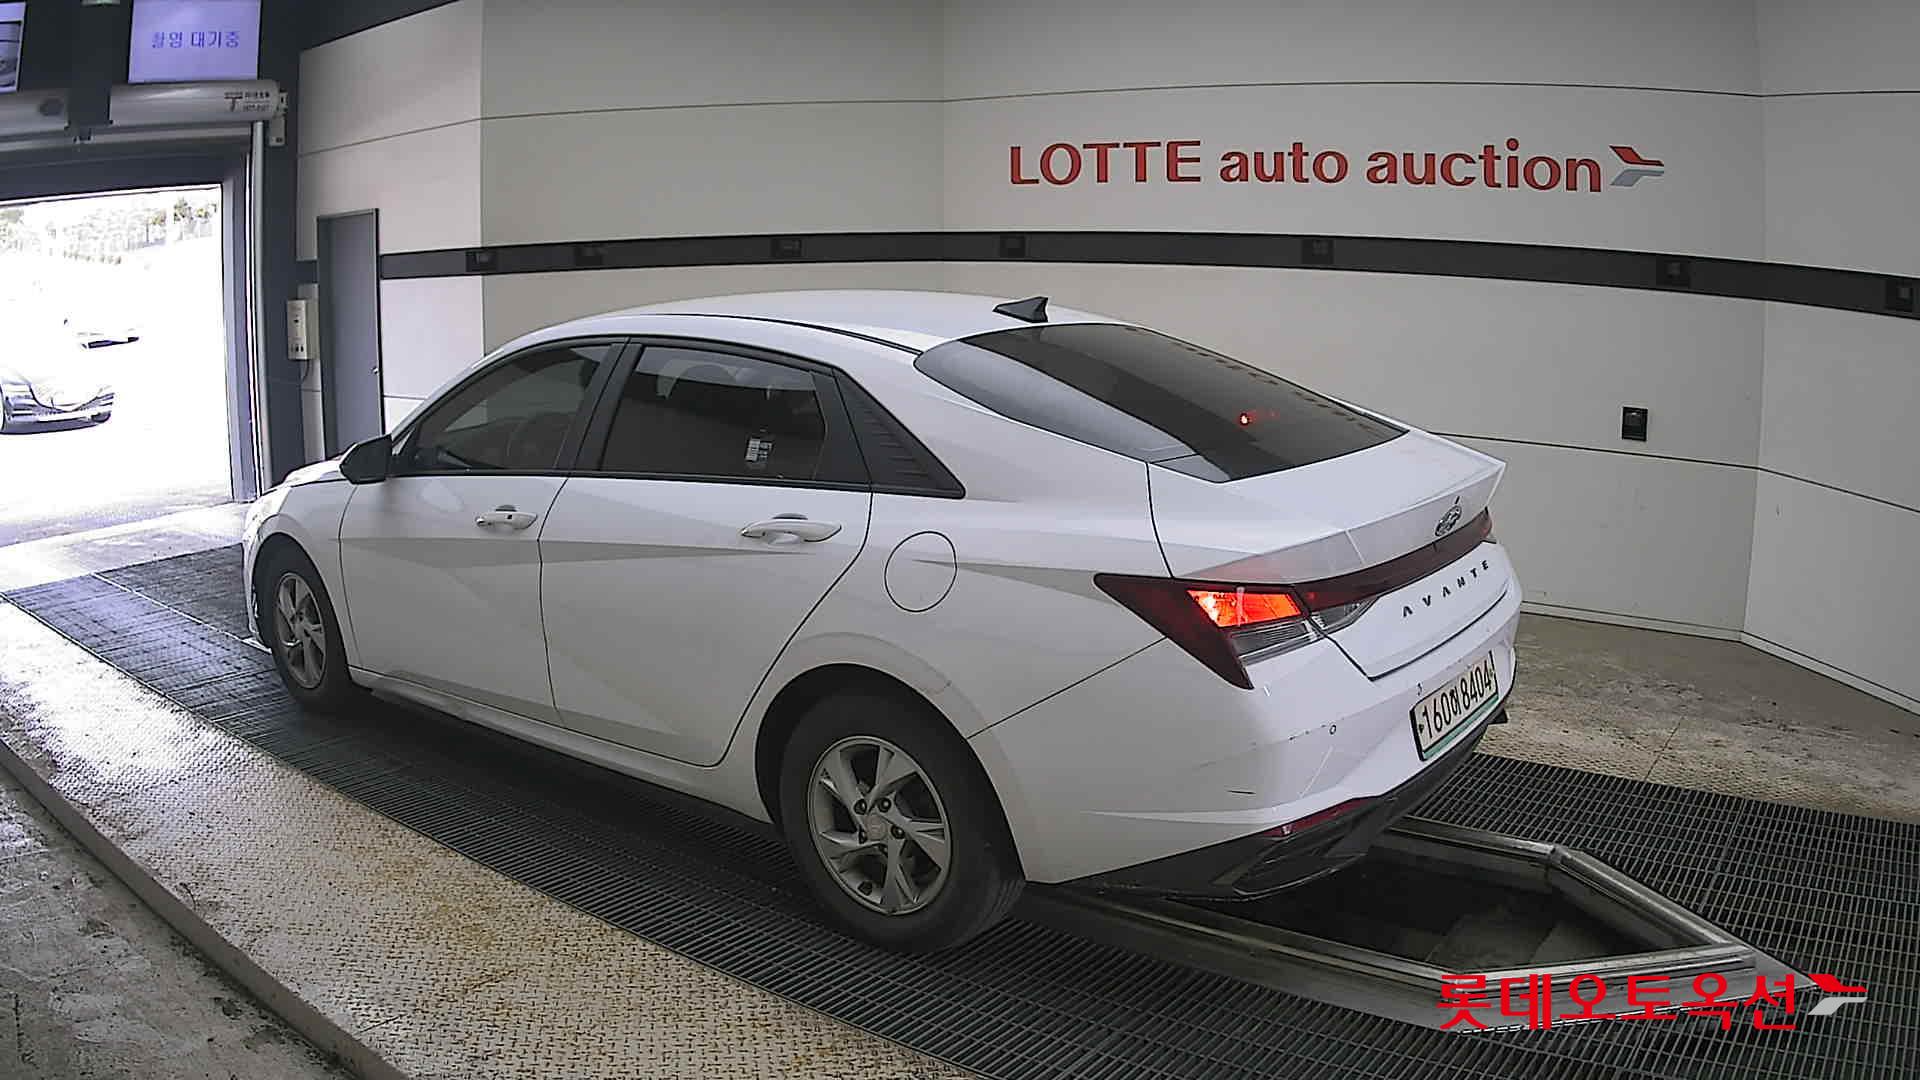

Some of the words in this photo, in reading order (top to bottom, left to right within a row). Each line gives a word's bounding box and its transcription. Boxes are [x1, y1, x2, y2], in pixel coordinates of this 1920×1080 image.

[191, 31, 240, 48] 대기중
[1010, 141, 1200, 186] LOTTE
[1218, 142, 1349, 184] auto
[1366, 138, 1602, 192] auction
[1402, 560, 1490, 618] AVANTE
